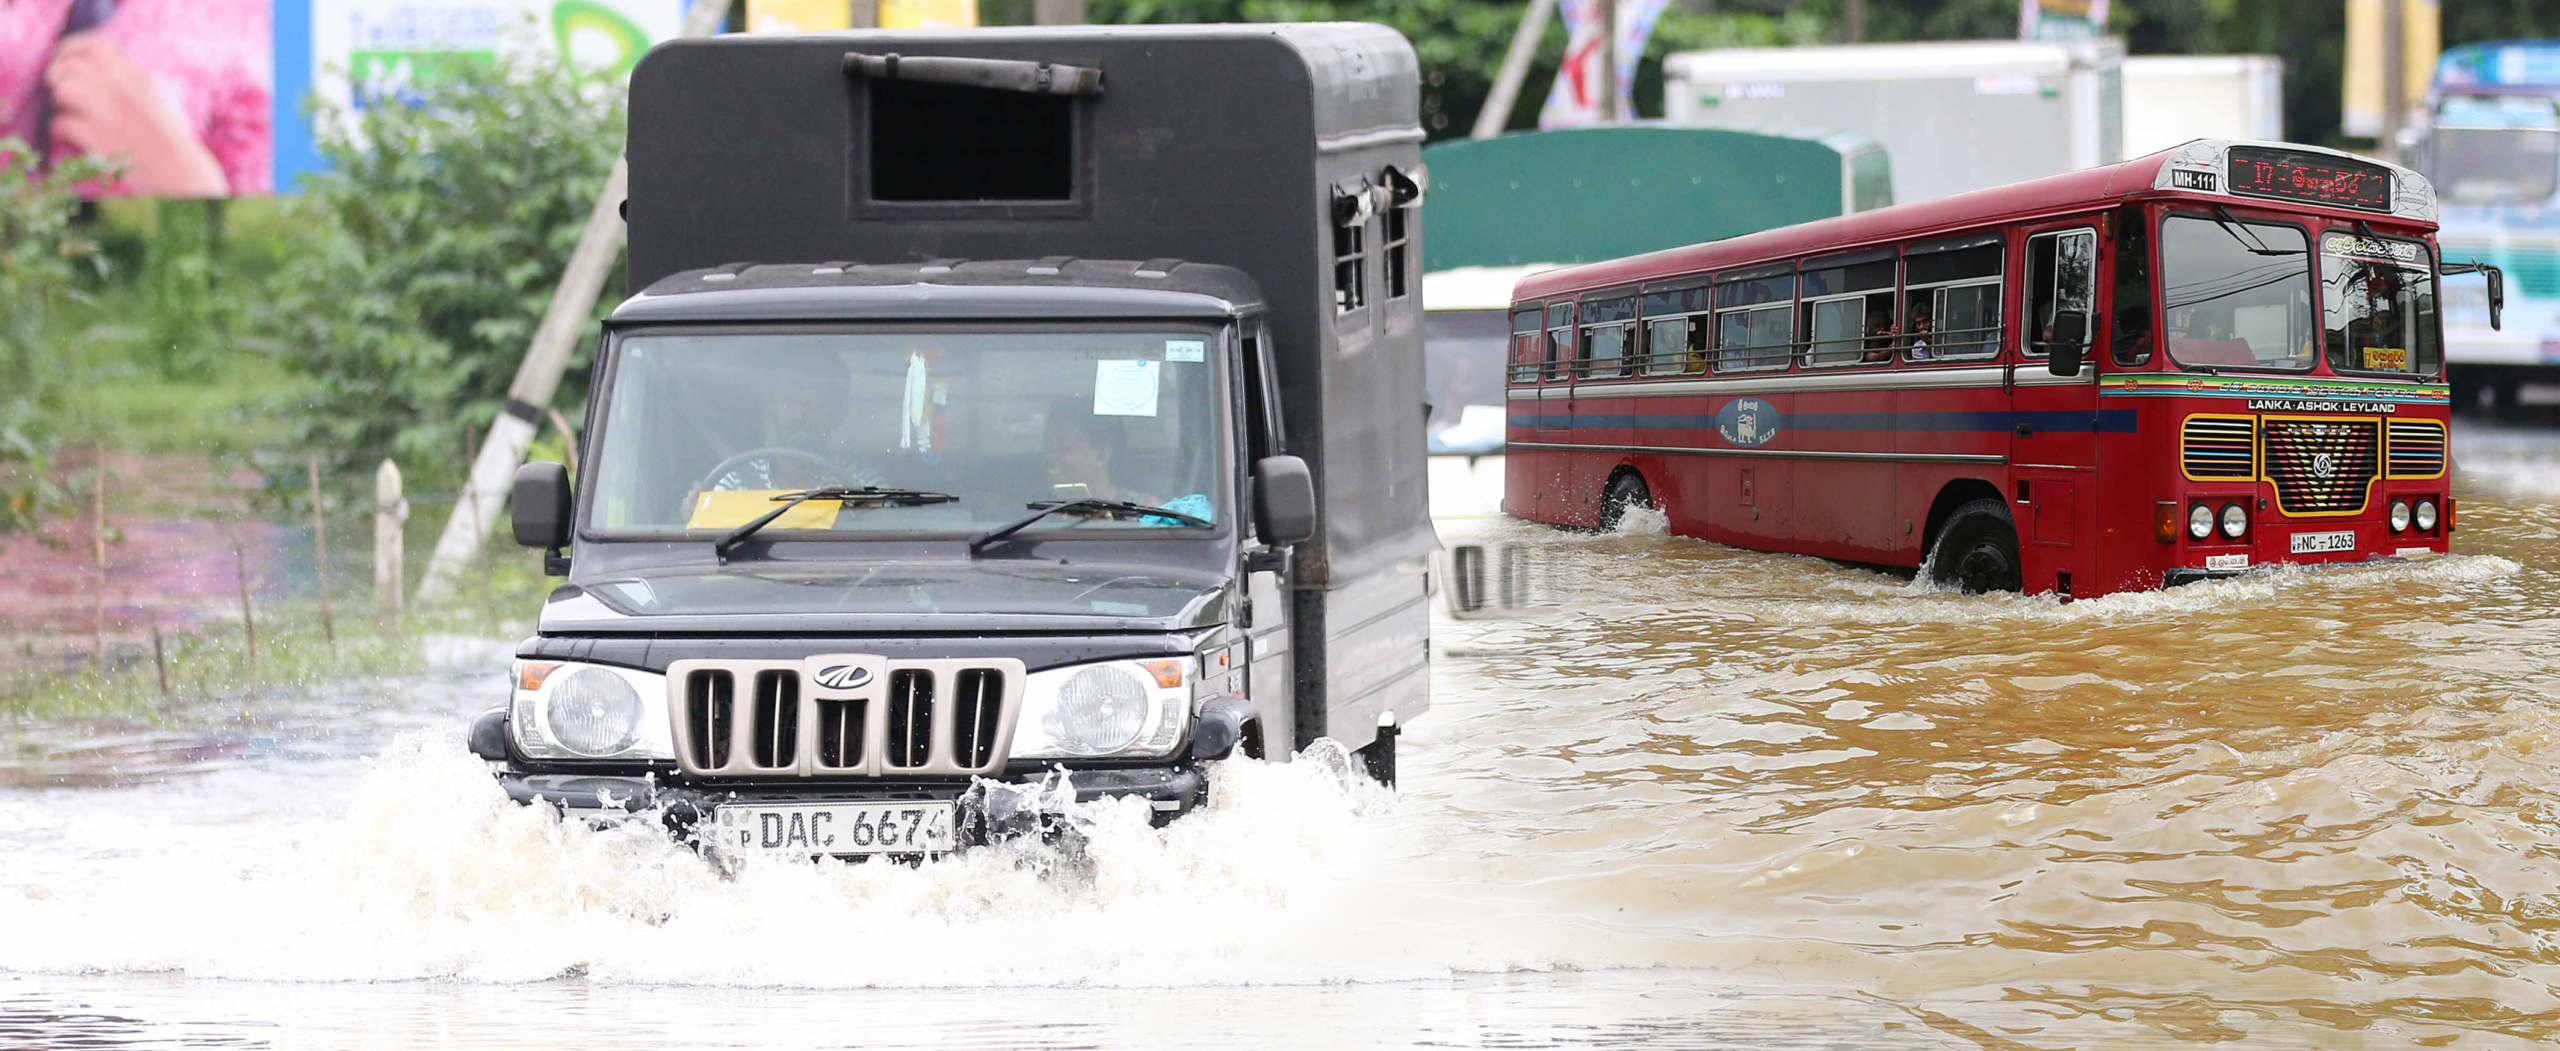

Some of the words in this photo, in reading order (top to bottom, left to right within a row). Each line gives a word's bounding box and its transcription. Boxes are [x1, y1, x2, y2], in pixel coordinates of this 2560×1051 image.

[2174, 171, 2216, 191] MH-111
[2248, 399, 2292, 411] LANKA
[2343, 402, 2396, 413] LEYLAND
[760, 811, 835, 849] DAC
